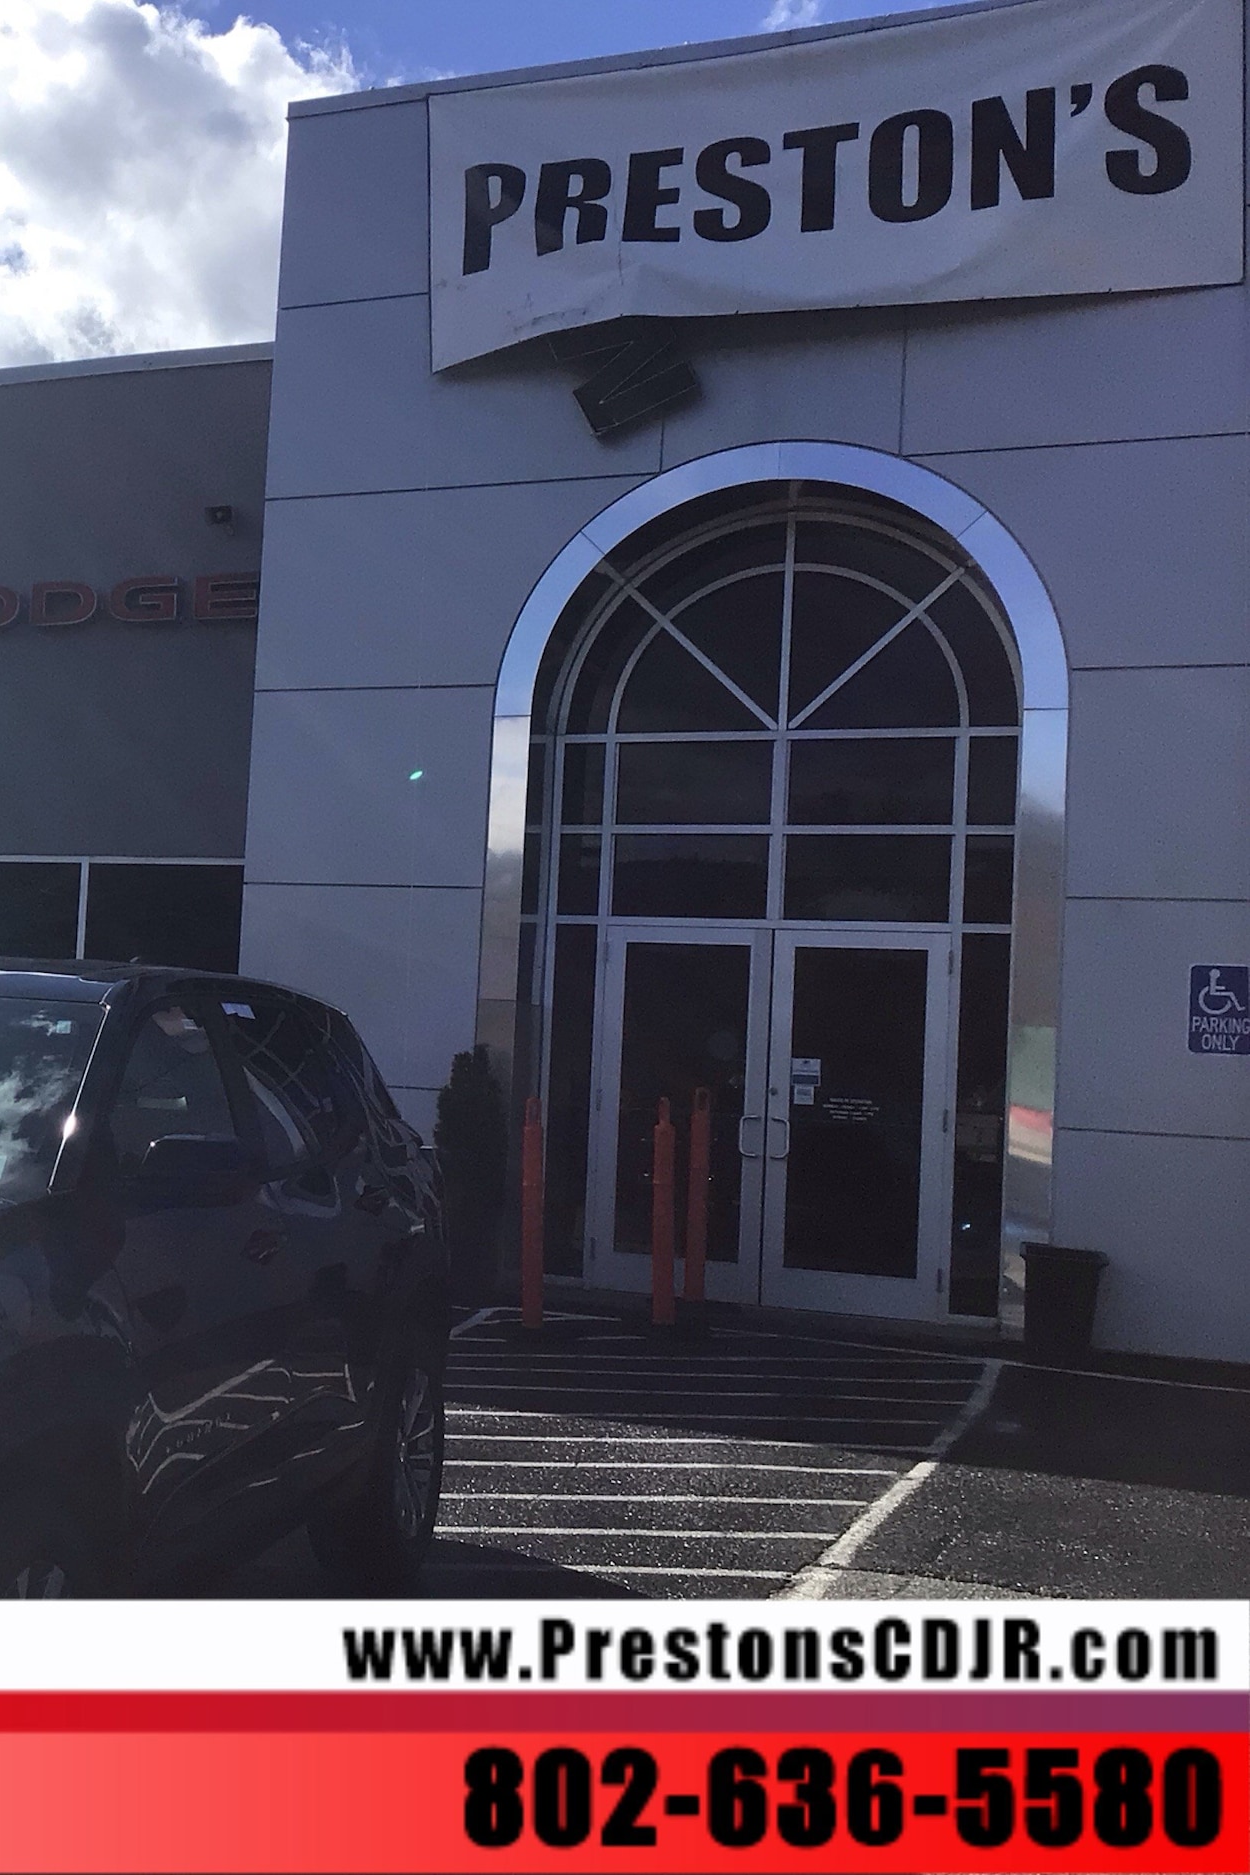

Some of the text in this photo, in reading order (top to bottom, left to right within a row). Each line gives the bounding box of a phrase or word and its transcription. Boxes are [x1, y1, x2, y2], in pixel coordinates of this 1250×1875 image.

[462, 63, 1192, 276] PRESTON'S
[1192, 1016, 1250, 1034] PARKING
[1201, 1033, 1240, 1051] ONLY
